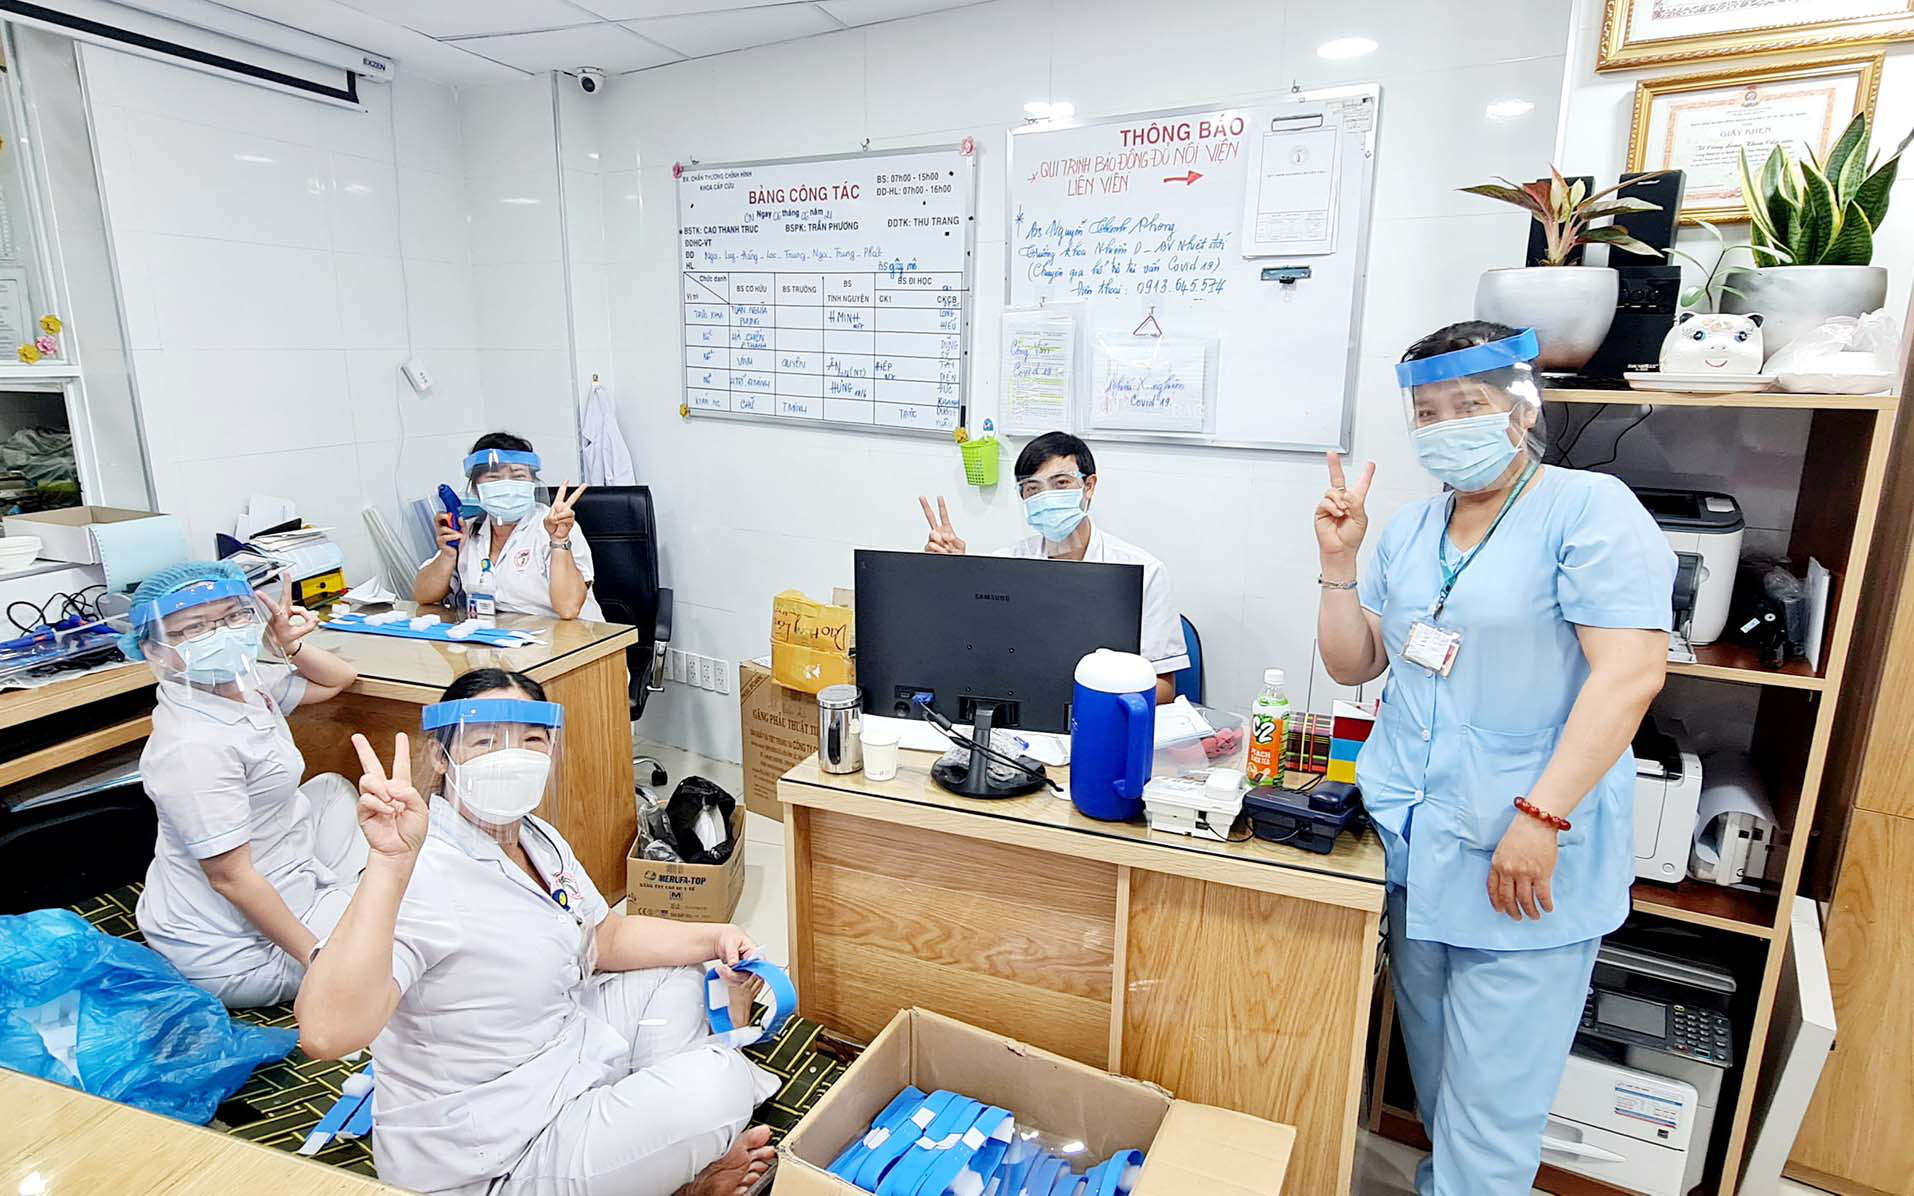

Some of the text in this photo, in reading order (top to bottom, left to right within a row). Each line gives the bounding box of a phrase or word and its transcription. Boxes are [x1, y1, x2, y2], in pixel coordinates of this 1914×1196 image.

[1120, 113, 1245, 147] THÔNG BÁO
[891, 174, 911, 182] 07h00
[918, 172, 939, 181] 15h00
[749, 180, 861, 205] BẢNG CÔNG TÁC
[902, 185, 924, 195] 07h00
[930, 184, 952, 193] 16h00
[913, 217, 930, 226] THU
[932, 216, 960, 226] TRANG
[703, 226, 717, 234] CAO
[718, 225, 740, 234] THANH
[785, 223, 807, 232] BSPK:
[897, 277, 907, 285] BS
[736, 285, 745, 293] BS
[782, 285, 791, 293] BS
[1252, 715, 1277, 743] C2
